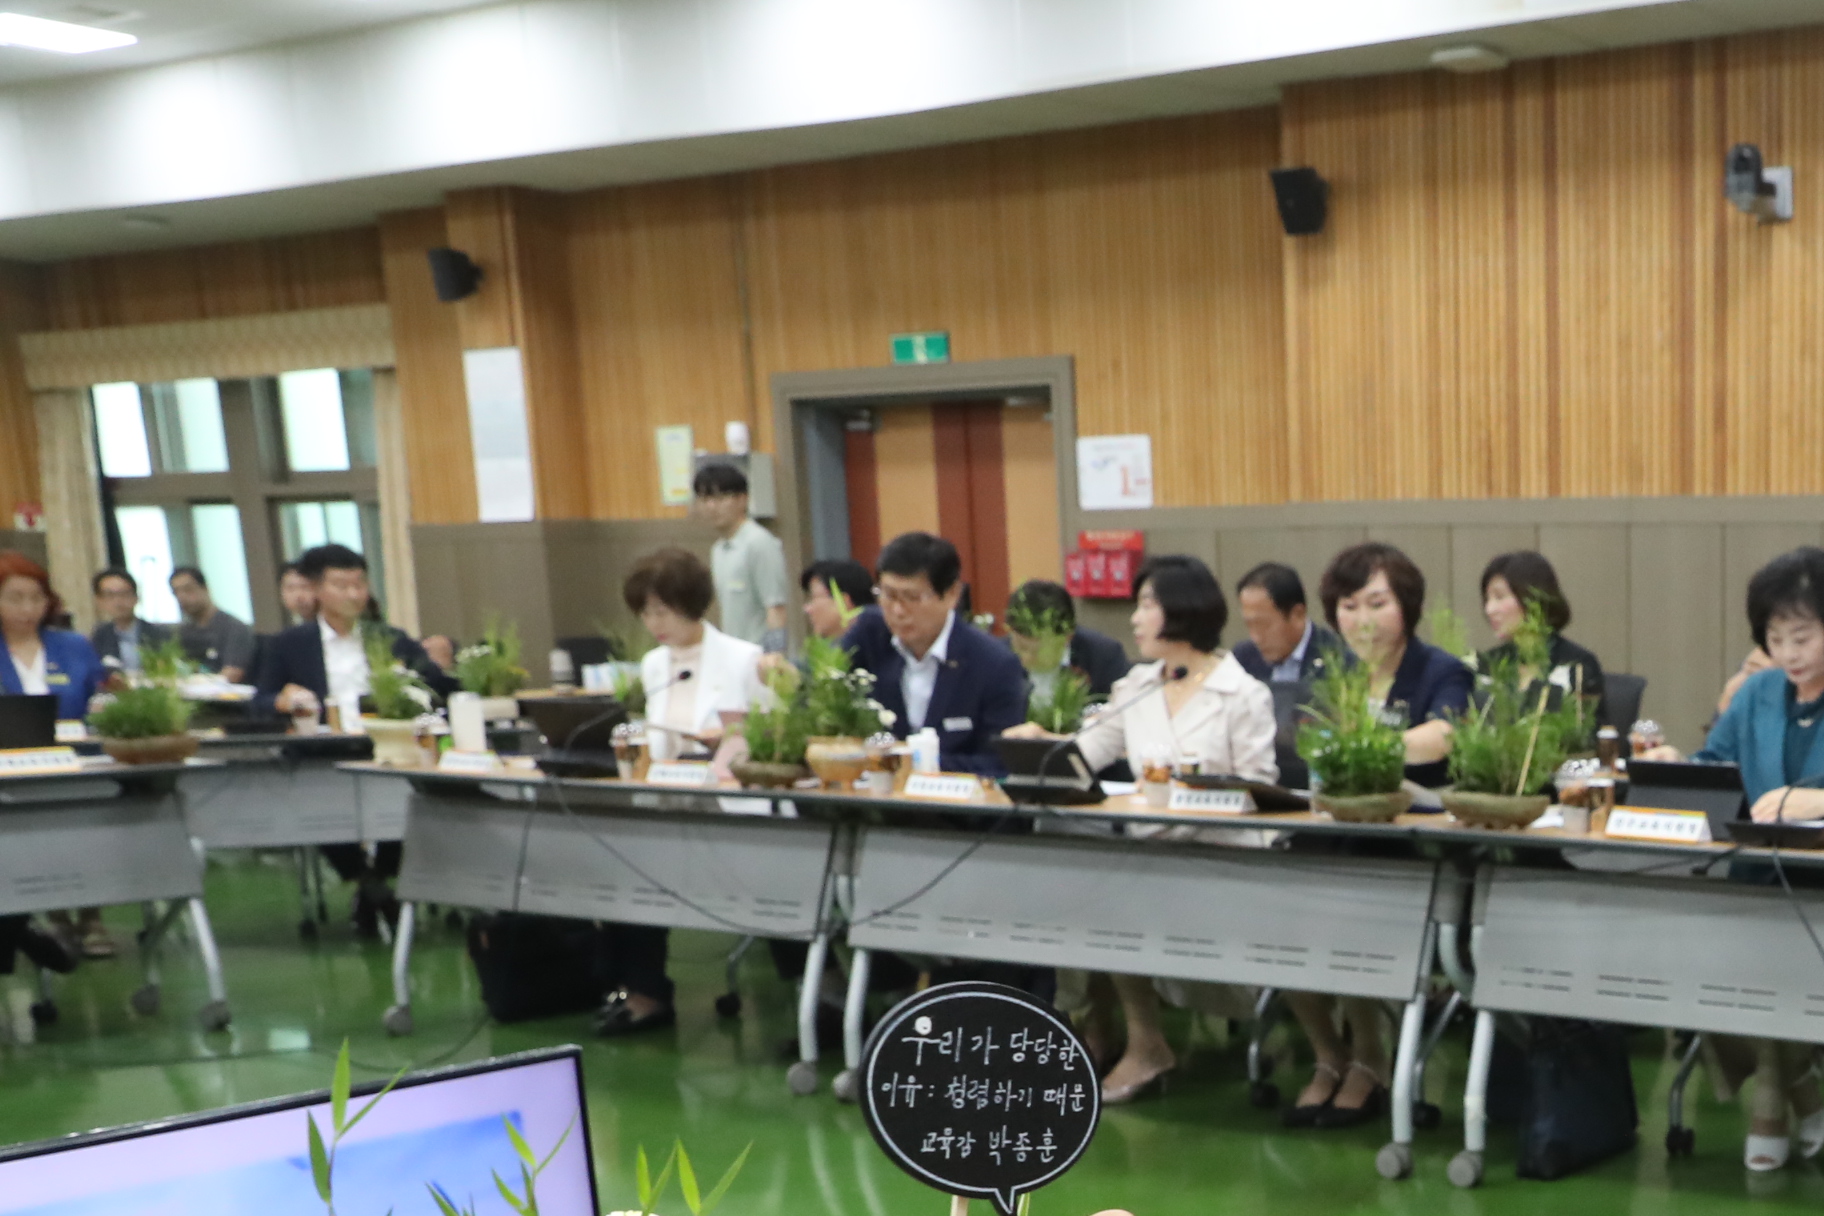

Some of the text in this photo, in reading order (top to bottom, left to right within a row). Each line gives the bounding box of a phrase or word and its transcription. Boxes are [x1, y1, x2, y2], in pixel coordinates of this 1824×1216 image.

[901, 1015, 1080, 1071] 우리가 당당한
[944, 1074, 1034, 1112] 청렴하기
[1043, 1082, 1086, 1116] 때문
[920, 1125, 1058, 1166] 교육감 박종훈
